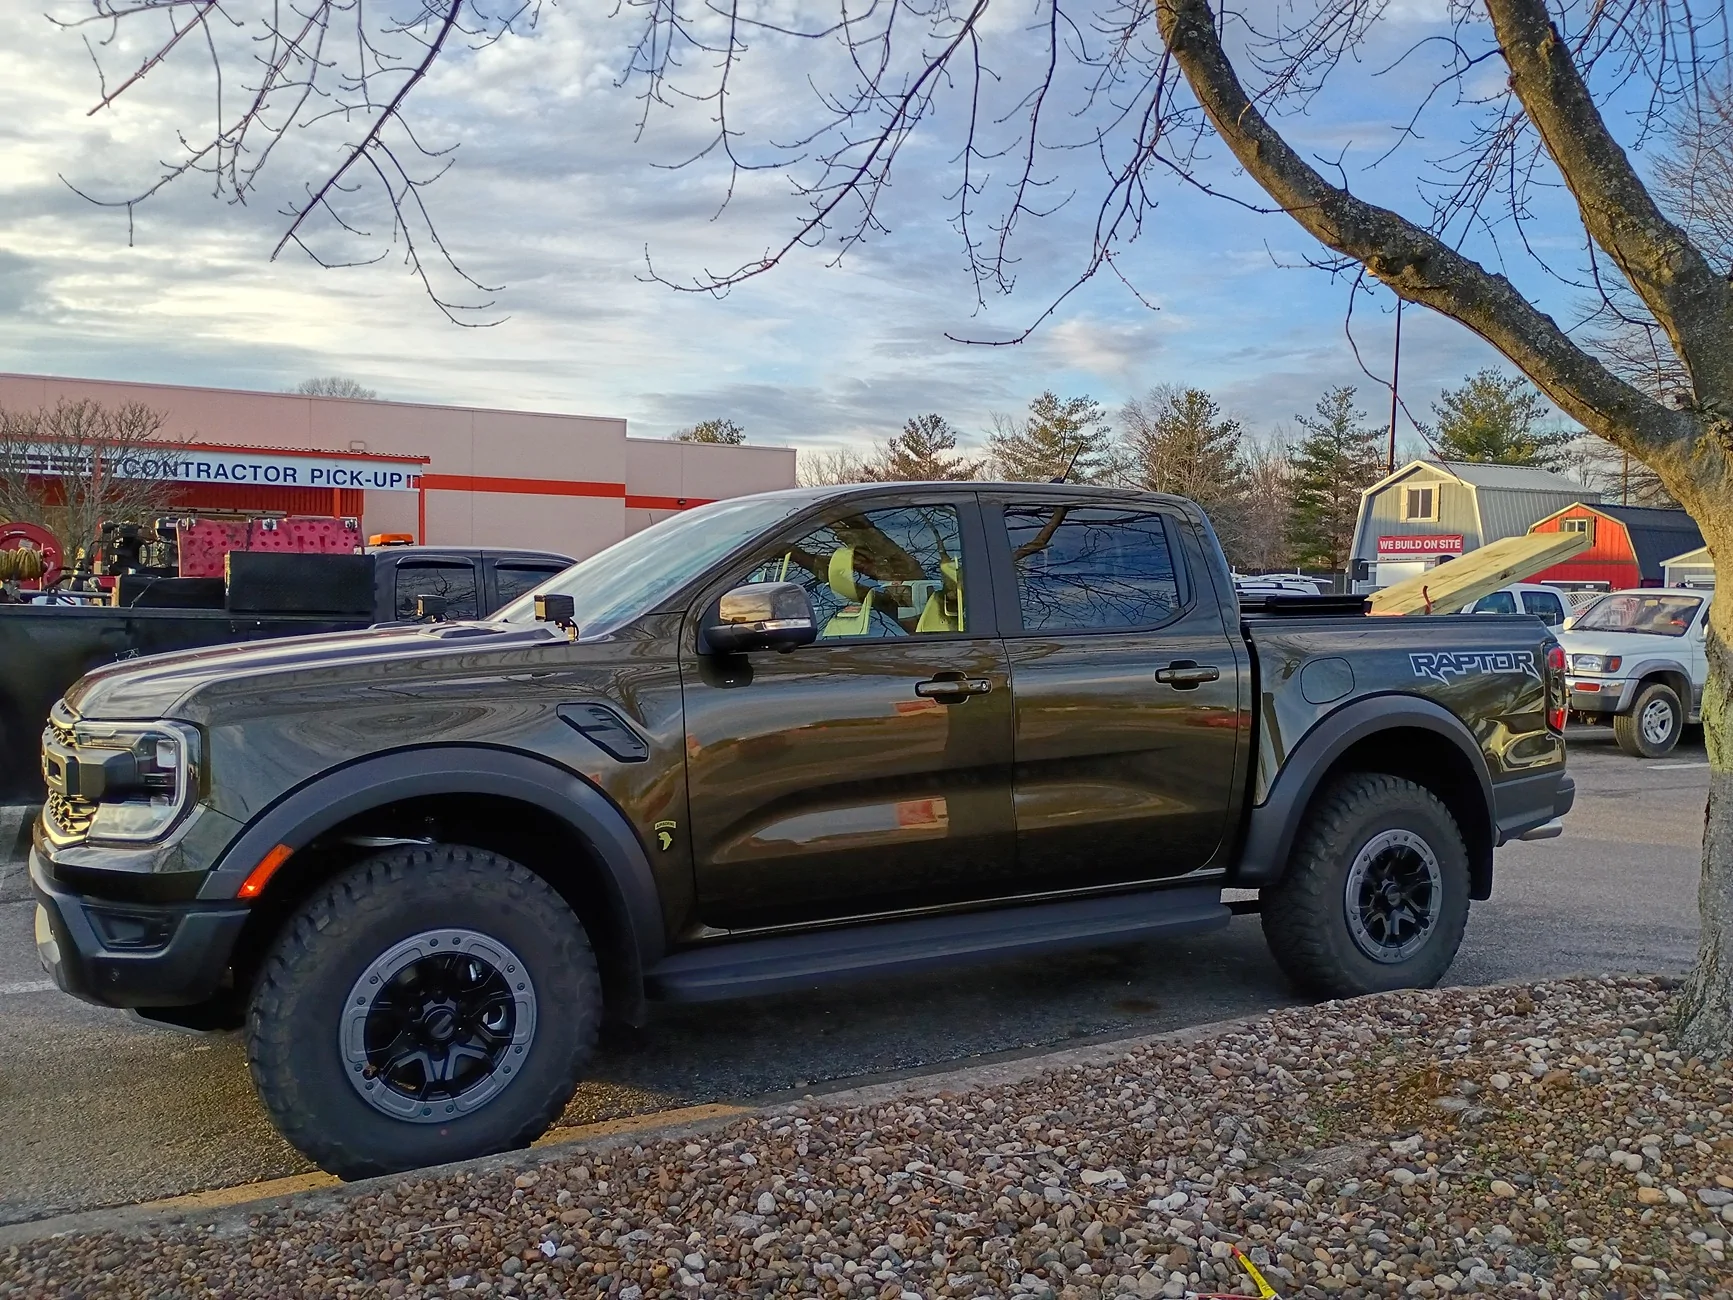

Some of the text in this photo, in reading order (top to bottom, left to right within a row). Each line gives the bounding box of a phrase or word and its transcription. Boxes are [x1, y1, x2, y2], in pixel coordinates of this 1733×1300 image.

[123, 457, 402, 488] CONTRACTOR PICK-UP
[1380, 539, 1461, 550] WE BUILD ON SITE
[1409, 651, 1542, 686] RAPTOR
